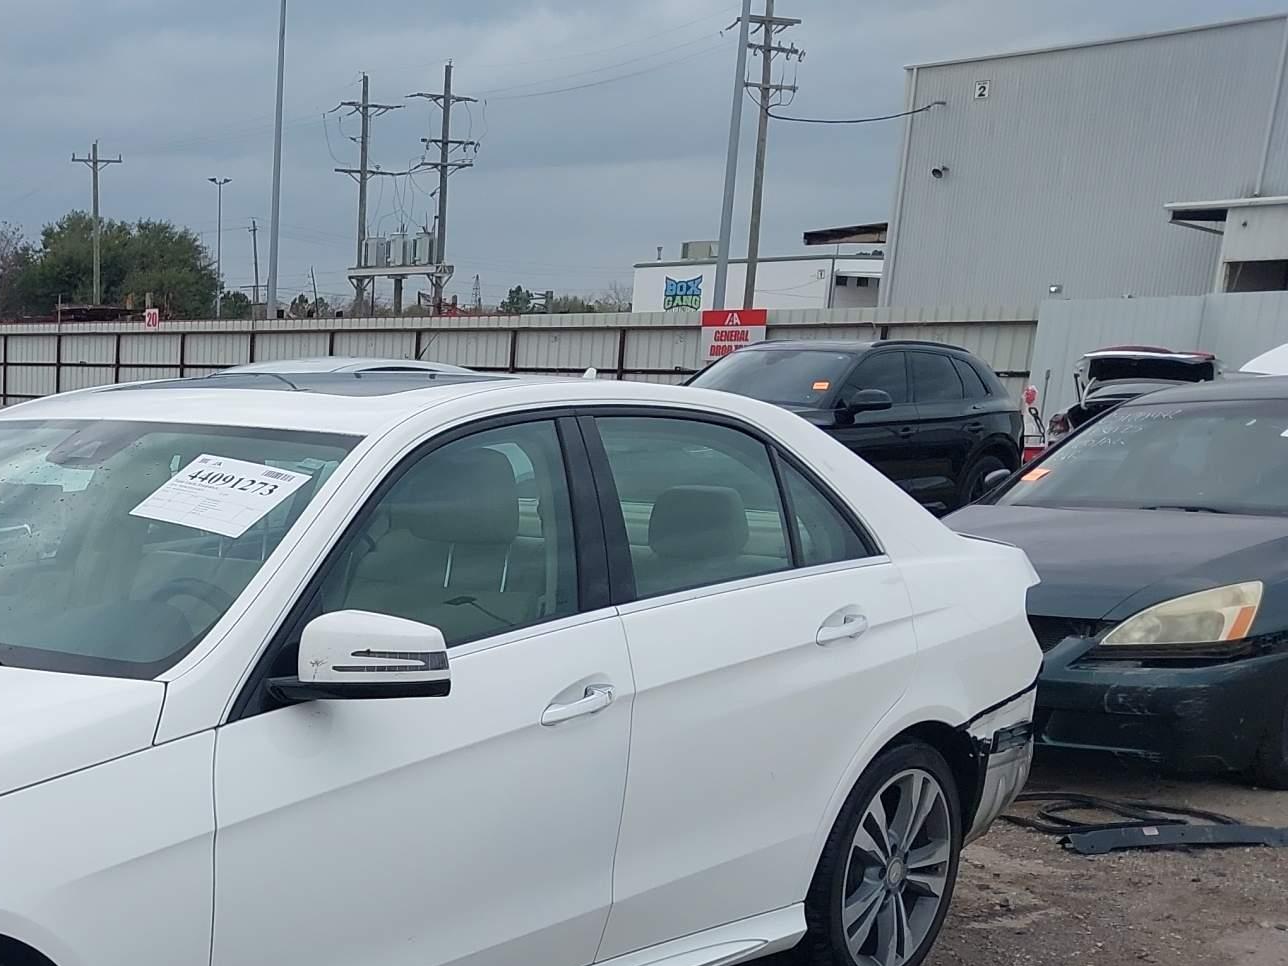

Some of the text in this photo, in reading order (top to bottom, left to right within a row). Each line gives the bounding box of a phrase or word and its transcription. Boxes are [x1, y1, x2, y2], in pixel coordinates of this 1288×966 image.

[978, 86, 986, 97] 2
[665, 276, 702, 296] BOX
[664, 296, 701, 310] GANG
[146, 311, 157, 327] 20
[713, 330, 749, 342] GENERAL
[188, 469, 279, 497] 44091273
